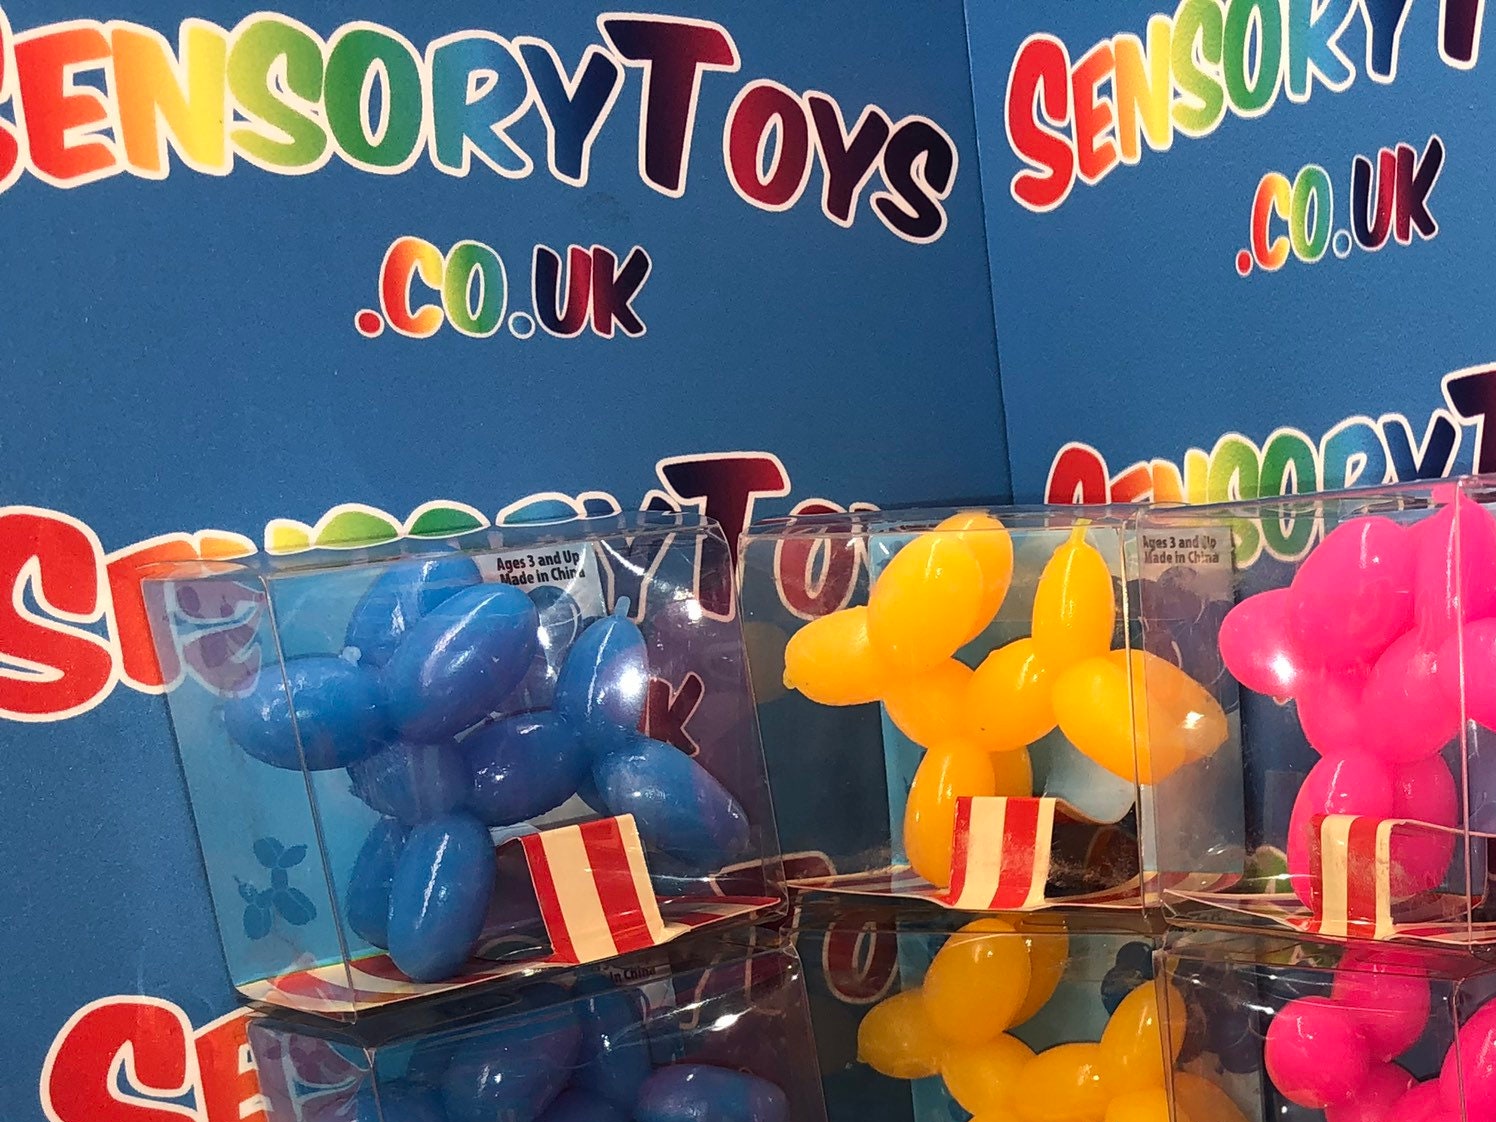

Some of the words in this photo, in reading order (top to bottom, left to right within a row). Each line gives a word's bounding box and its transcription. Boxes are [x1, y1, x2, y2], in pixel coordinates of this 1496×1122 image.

[0, 10, 957, 244] ENSORYTOYS
[1235, 135, 1445, 276] .CO.UK
[353, 236, 651, 338] .CO.UK
[1142, 535, 1167, 551] Ages
[1169, 536, 1176, 548] 3
[1178, 535, 1199, 549] and
[497, 557, 526, 573] Ages
[527, 554, 536, 567] 3
[538, 551, 562, 566] and
[563, 550, 580, 566] Up
[1144, 551, 1173, 564] Made
[1175, 550, 1186, 563] in
[1188, 551, 1220, 563] China
[500, 570, 534, 585] Made
[536, 569, 549, 582] in
[551, 566, 586, 581] China
